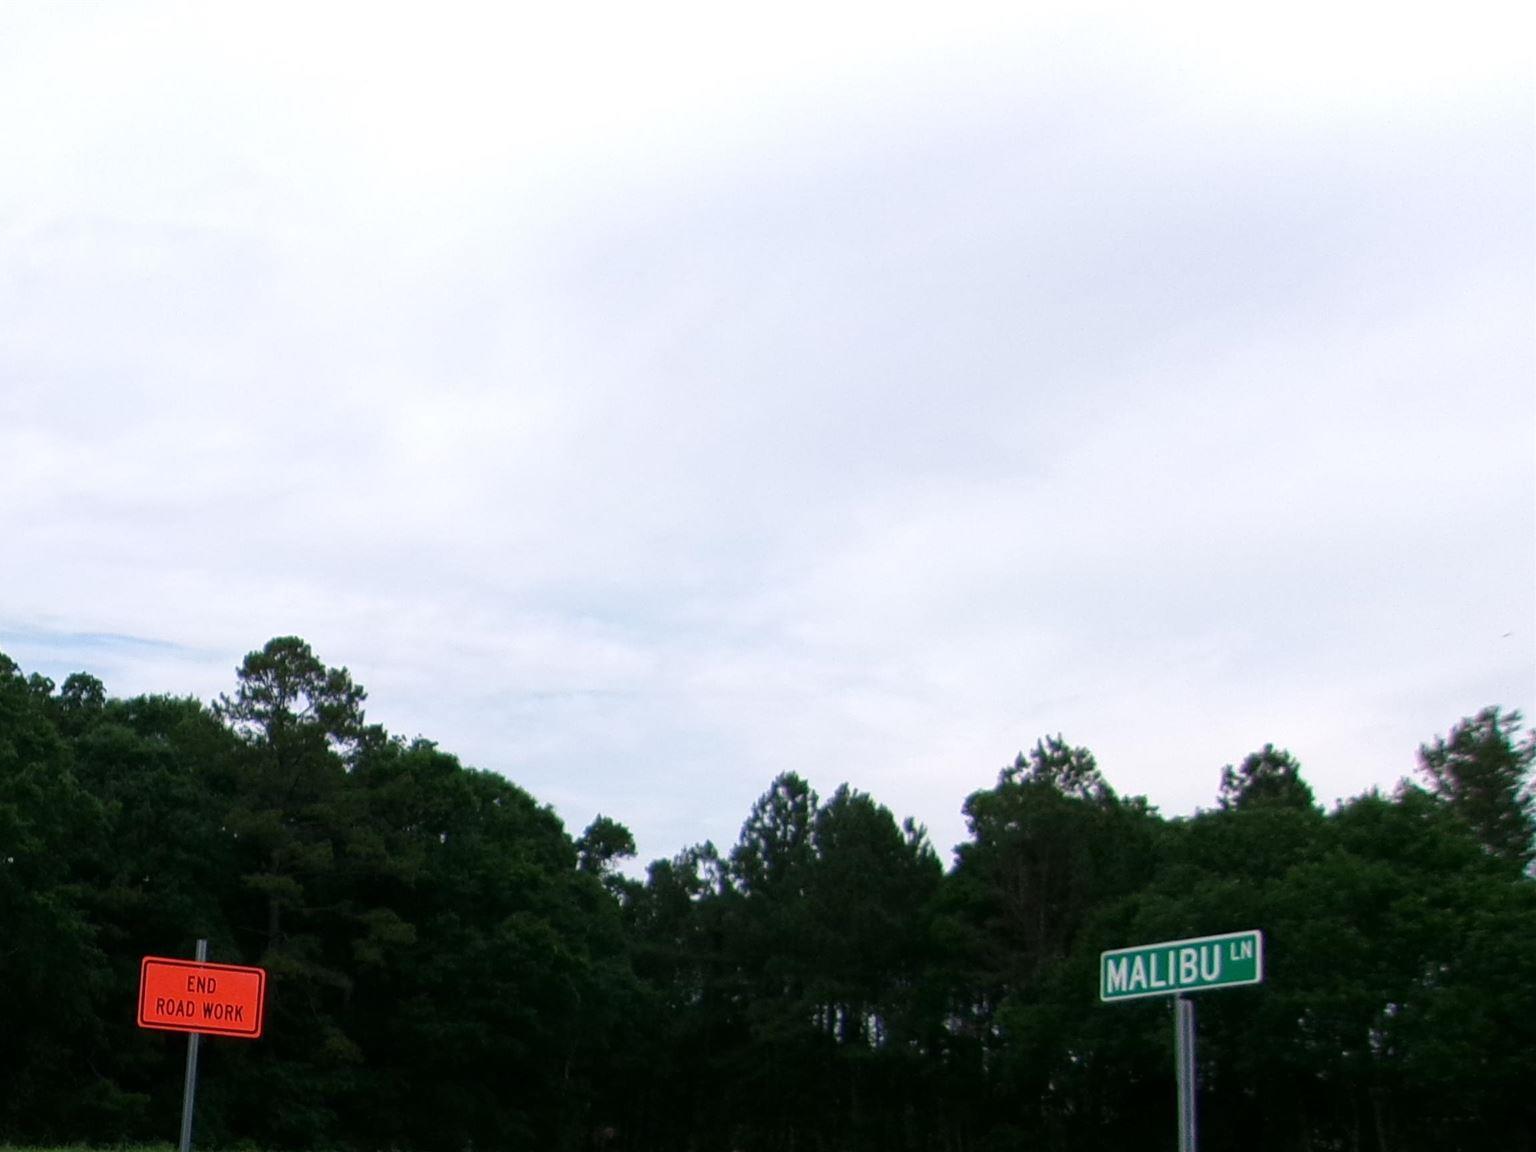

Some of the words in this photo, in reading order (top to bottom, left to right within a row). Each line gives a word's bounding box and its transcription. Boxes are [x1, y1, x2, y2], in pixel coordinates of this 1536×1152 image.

[1106, 944, 1221, 994] MALIBU
[1230, 940, 1253, 960] LN
[187, 975, 217, 994] END
[156, 998, 195, 1017] ROAD
[203, 1001, 243, 1022] WORK
